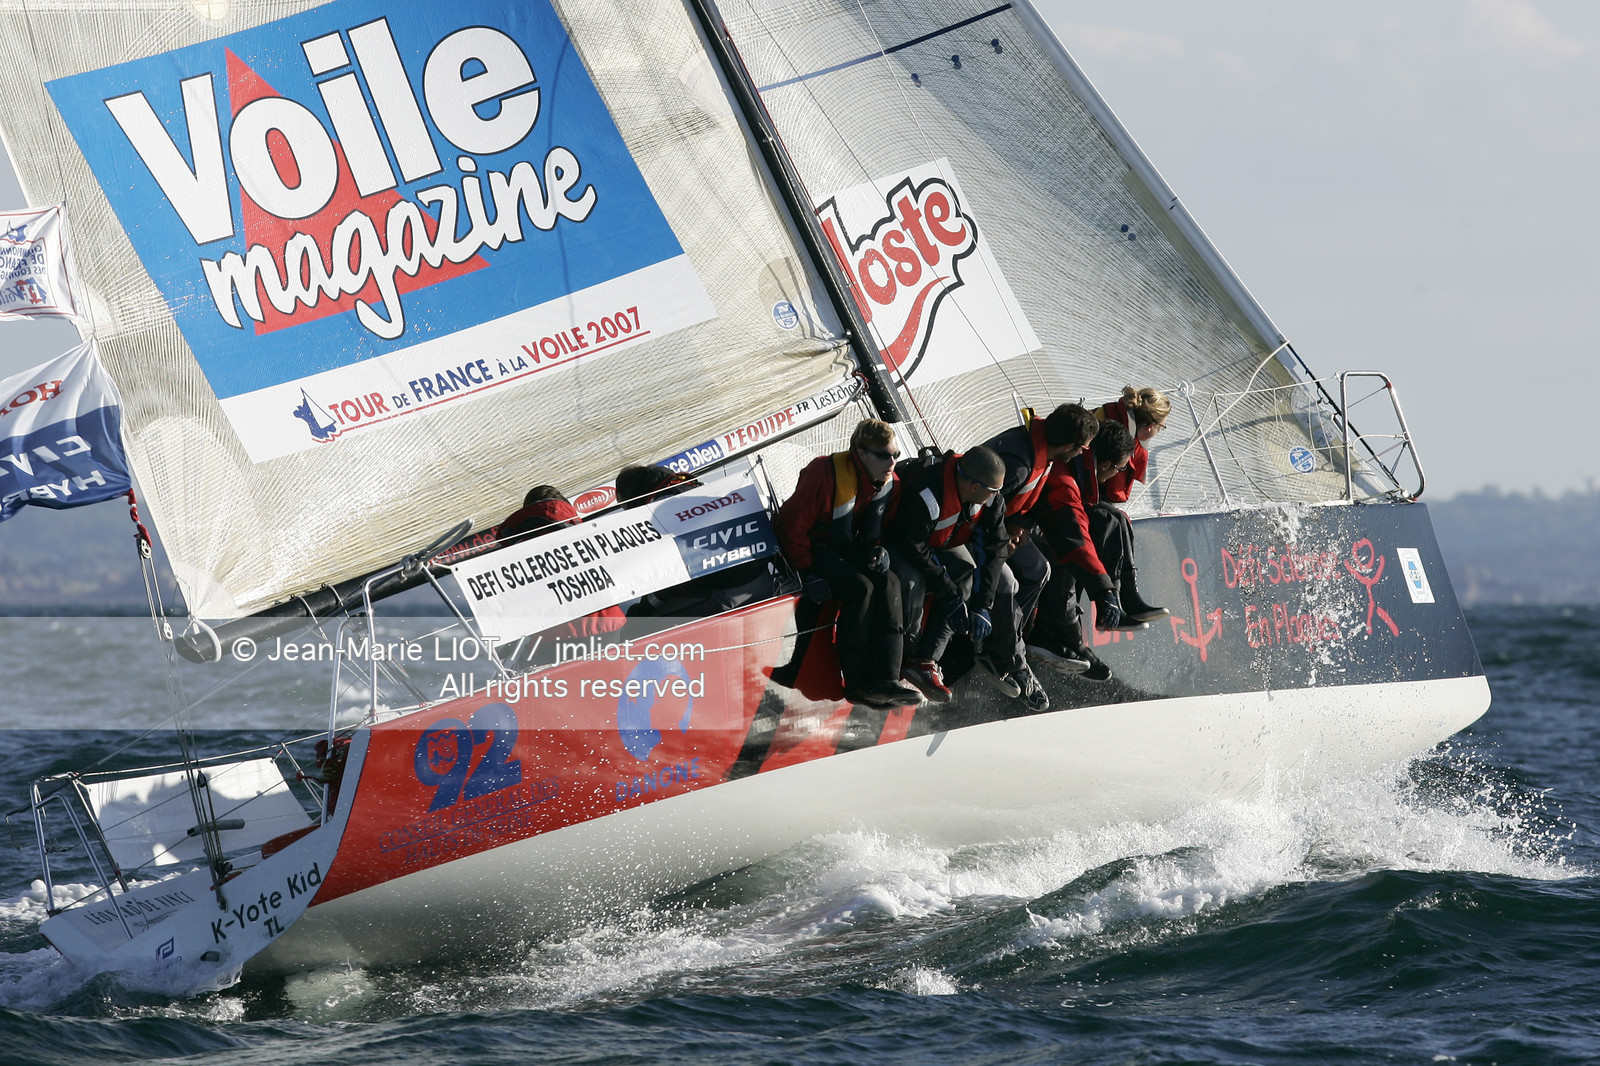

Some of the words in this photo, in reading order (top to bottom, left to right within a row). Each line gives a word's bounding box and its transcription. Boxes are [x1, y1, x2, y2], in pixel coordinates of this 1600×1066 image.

[103, 16, 541, 245] Voile
[200, 145, 597, 340] magazine
[328, 391, 391, 426] TOUR
[392, 393, 411, 410] DE
[408, 359, 494, 402] FRANCE
[498, 358, 510, 377] À
[509, 355, 529, 373] LA
[521, 326, 590, 365] VOILE
[587, 306, 642, 344] 2007
[687, 444, 722, 469] bleu
[675, 492, 746, 522] HONDA
[693, 520, 759, 550] CIVIC
[703, 541, 767, 570] HYBRID
[467, 570, 505, 601] DEFI
[501, 545, 579, 589] SCLEROSE
[573, 537, 600, 564] EN
[594, 520, 662, 557] PLAQUES
[547, 565, 615, 605] TOSHIBA
[1244, 604, 1273, 648] En
[414, 702, 523, 813] 92
[615, 757, 700, 802] DANONE
[378, 814, 448, 850] CONSEIL
[530, 776, 561, 800] DES
[211, 891, 282, 944] K-Yote
[287, 862, 322, 900] Kid
[263, 915, 285, 938] TL
